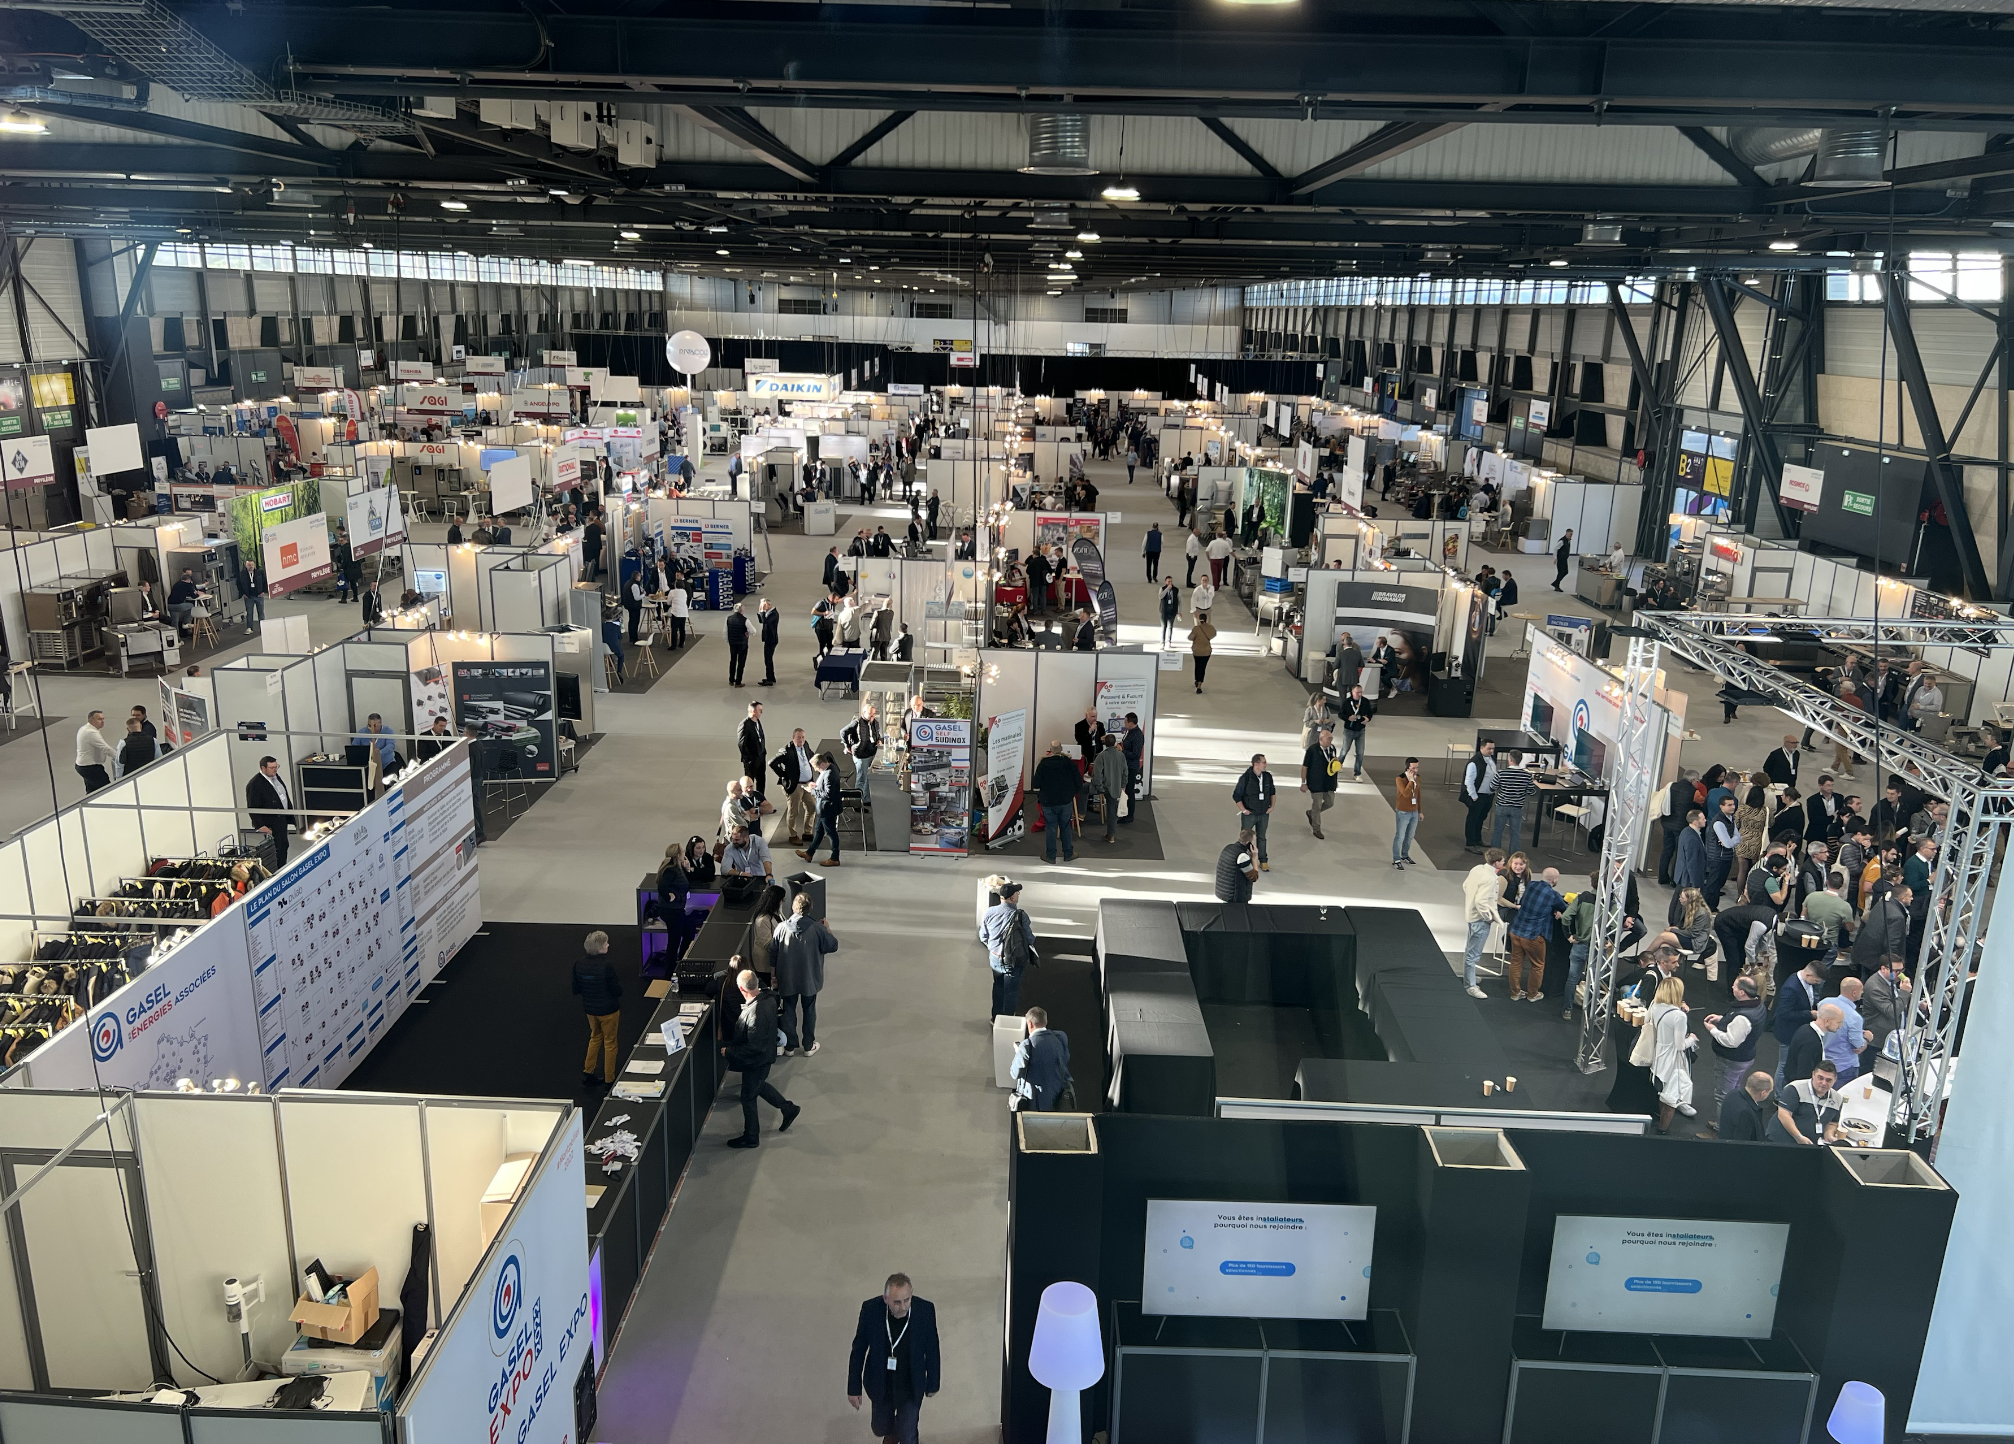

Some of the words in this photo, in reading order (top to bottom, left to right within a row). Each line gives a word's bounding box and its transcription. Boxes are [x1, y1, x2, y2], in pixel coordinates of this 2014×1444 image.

[769, 382, 823, 394] DAIKIN
[419, 395, 448, 407] SAGI
[419, 444, 445, 454] SAGI
[264, 494, 291, 508] HOBART
[1856, 496, 1871, 505] SORTIE
[1852, 502, 1872, 513] SECOURS
[282, 552, 298, 566] nmc
[310, 564, 331, 579] PRIVILÈGE
[935, 724, 963, 732] GASEL
[935, 736, 966, 744] SUDINOX
[992, 737, 1000, 745] Les
[1001, 732, 1022, 743] matinales
[423, 757, 451, 785] PROGRAMME
[250, 901, 258, 913] LE
[258, 890, 272, 907] PLAN
[272, 886, 281, 897] DU
[281, 871, 299, 890] SALON
[298, 860, 314, 876] GASEL
[314, 849, 327, 865] EXPO
[126, 982, 171, 1026] GASEL
[131, 1000, 173, 1041] ÉNERGIES
[174, 965, 217, 1006] ASSOCIÉES
[674, 1038, 682, 1050] Z
[563, 1150, 575, 1172] 2022
[1238, 1214, 1254, 1222] êtes
[1255, 1215, 1305, 1224] installateurs,
[1213, 1222, 1248, 1230] pourquoi
[1269, 1223, 1304, 1231] rejoindre
[1647, 1230, 1663, 1238] êtes
[1665, 1232, 1715, 1241] installateurs,
[1621, 1239, 1657, 1247] pourquoi
[1678, 1240, 1713, 1249] rejoindre
[487, 1319, 532, 1415] GASEL
[516, 1361, 558, 1444] GASEL
[559, 1292, 588, 1363] EXPO
[489, 1348, 533, 1444] EXPO
